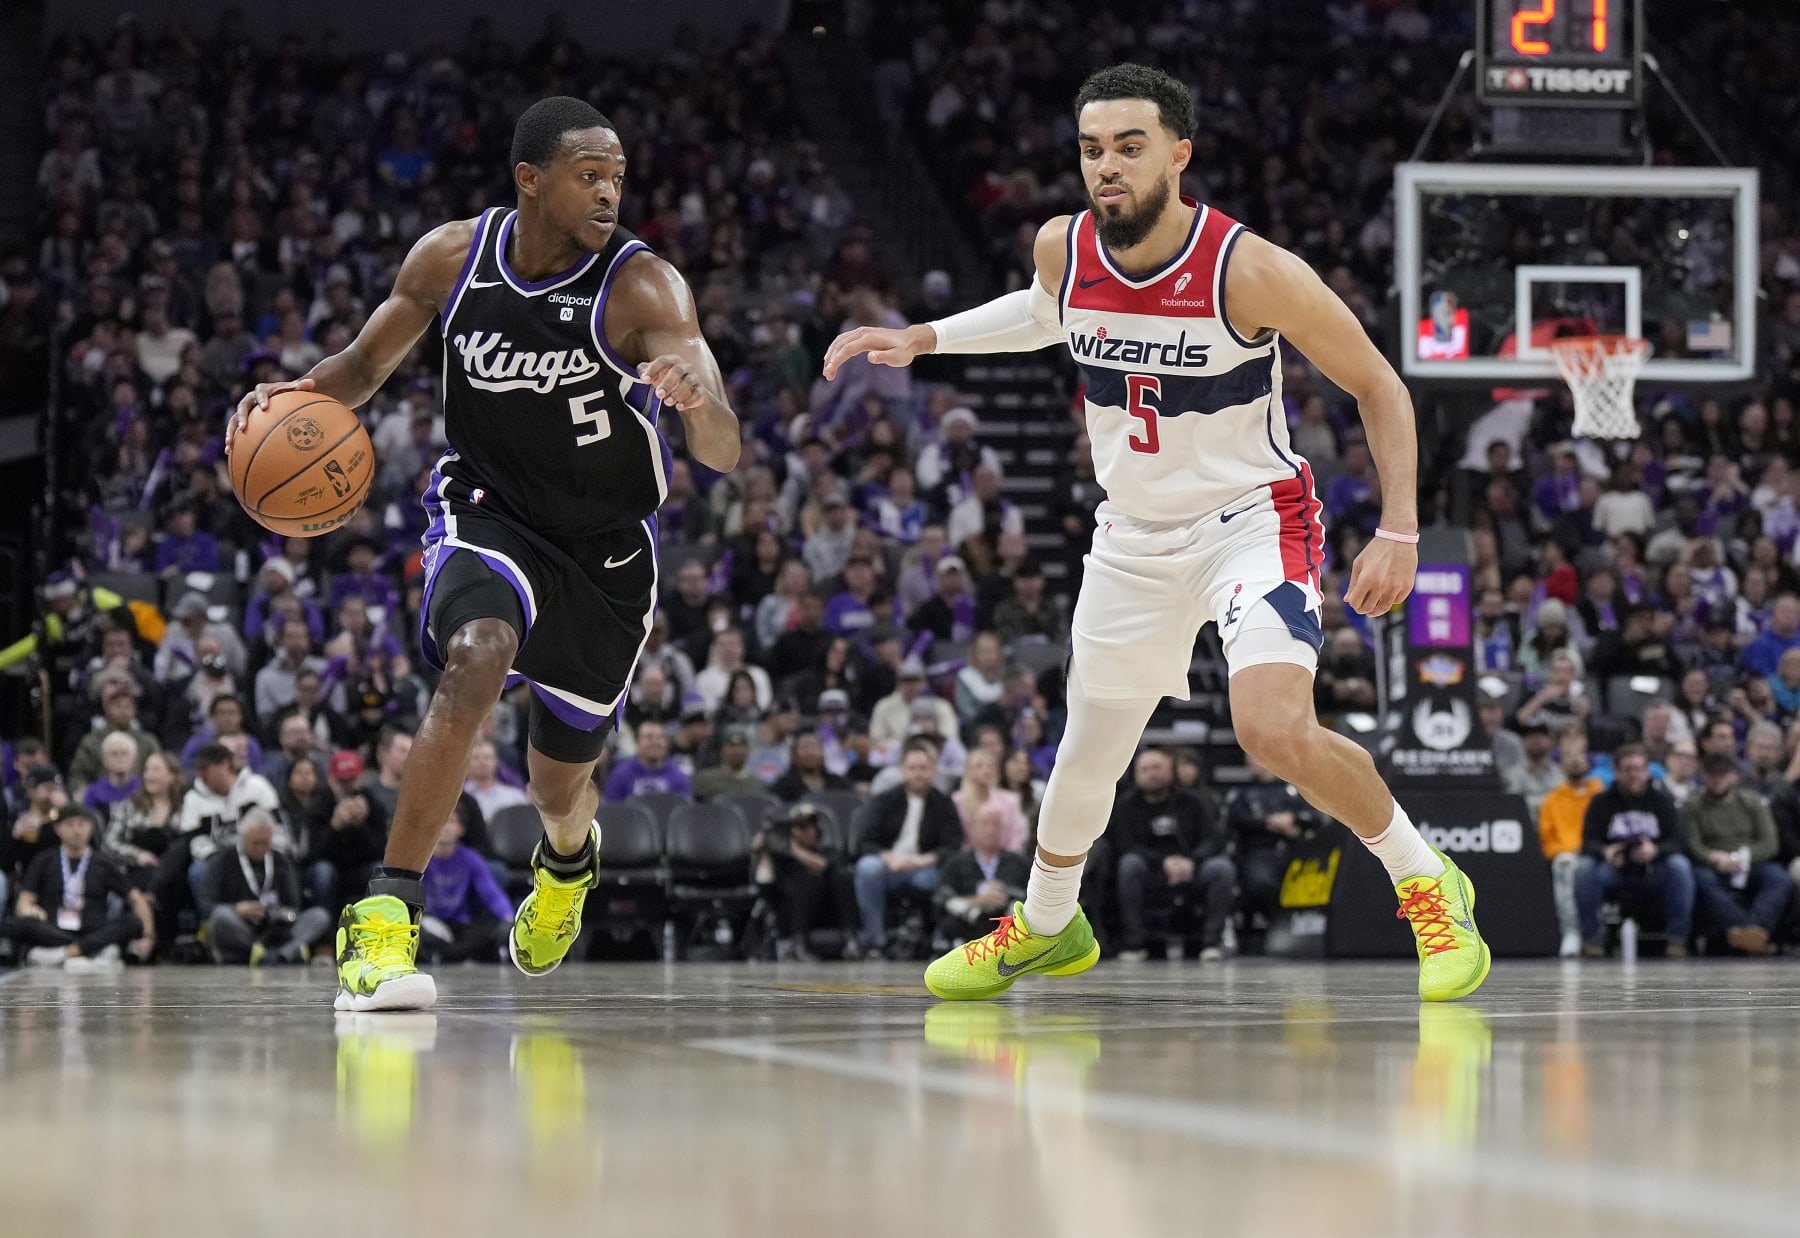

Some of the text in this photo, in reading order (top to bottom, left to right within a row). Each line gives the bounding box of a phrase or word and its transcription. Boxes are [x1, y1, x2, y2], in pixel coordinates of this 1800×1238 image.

[1527, 68, 1632, 93] TISSOT
[548, 292, 592, 306] dialpad
[1161, 298, 1205, 307] Robinhood
[454, 331, 600, 394] Kings
[1070, 327, 1212, 367] wizards
[568, 389, 611, 447] 5
[1127, 375, 1160, 455] 5
